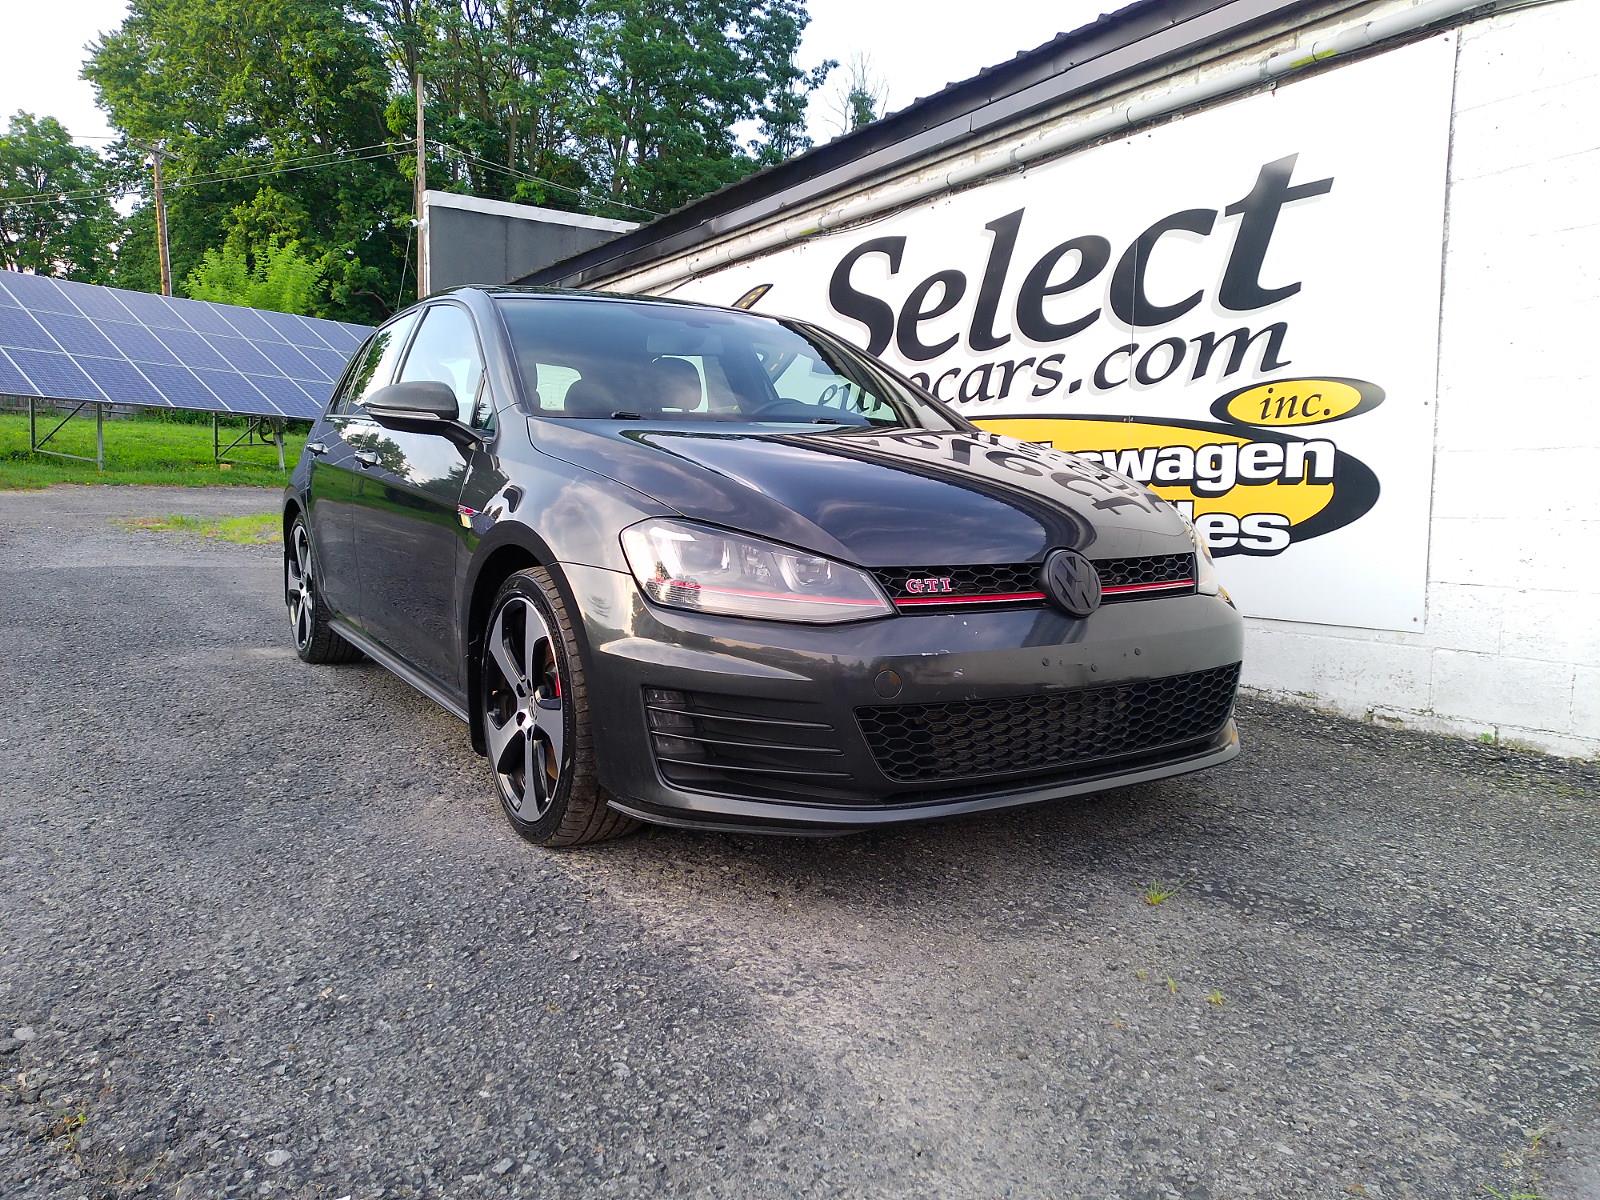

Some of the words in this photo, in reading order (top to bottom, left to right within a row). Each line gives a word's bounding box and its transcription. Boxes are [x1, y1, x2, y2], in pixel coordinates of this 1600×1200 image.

[829, 153, 1334, 361] Select
[817, 322, 1292, 413] eucars.com
[1260, 388, 1331, 420] inc.
[906, 577, 952, 593] GTI
